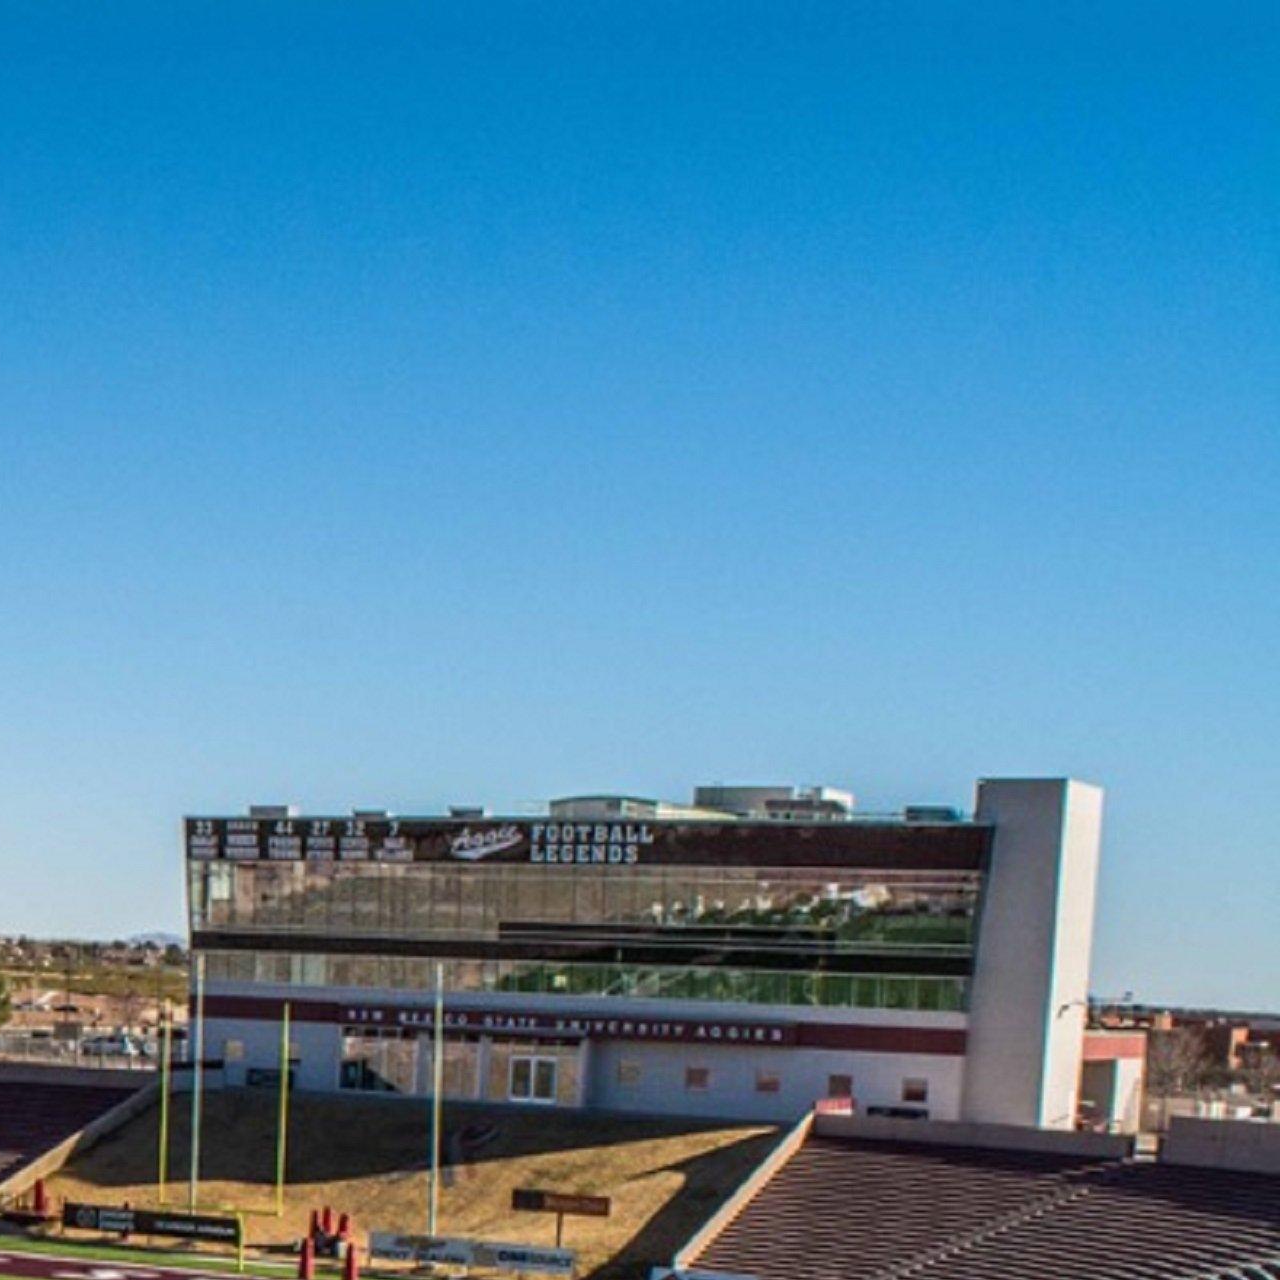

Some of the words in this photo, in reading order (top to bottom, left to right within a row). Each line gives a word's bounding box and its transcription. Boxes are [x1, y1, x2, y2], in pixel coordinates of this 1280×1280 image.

[532, 825, 653, 844] FOOTBALL
[531, 844, 638, 862] LEGENDS
[398, 1011, 468, 1025] MEXCO
[697, 1025, 782, 1041] AGGIES
